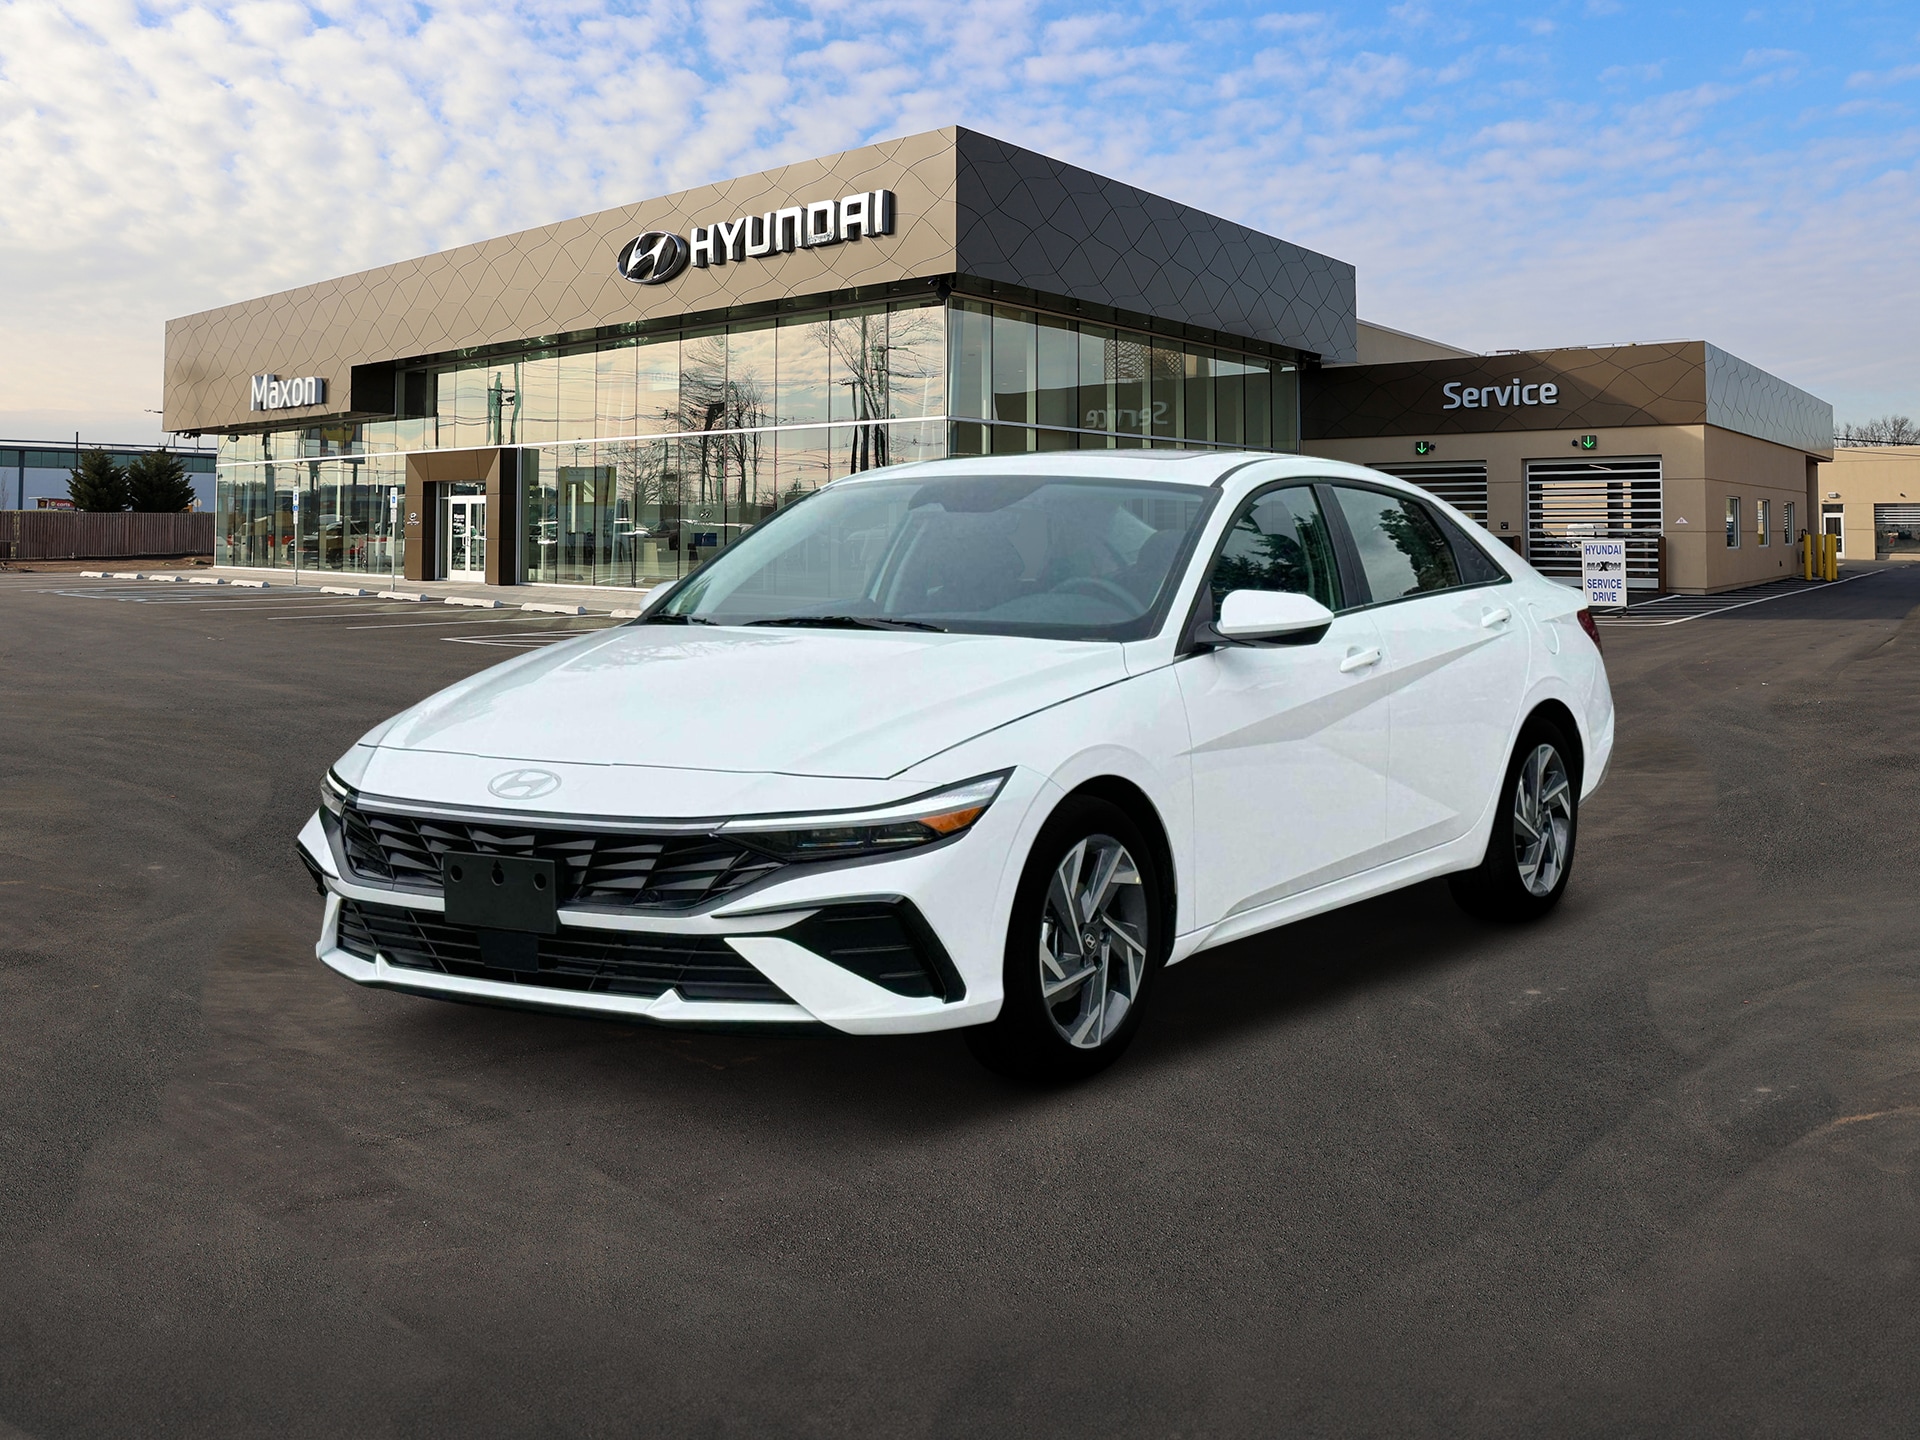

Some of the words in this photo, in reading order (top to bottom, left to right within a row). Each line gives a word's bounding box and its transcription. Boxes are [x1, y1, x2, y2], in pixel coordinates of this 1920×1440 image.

[690, 189, 894, 267] HYUNDAI
[250, 374, 322, 411] Maxon
[1443, 378, 1558, 409] Service
[1585, 545, 1622, 555] HYUNDAI
[1586, 561, 1622, 572] MAXON
[1587, 579, 1622, 589] SERVICE
[1592, 592, 1617, 602] DRIVE
